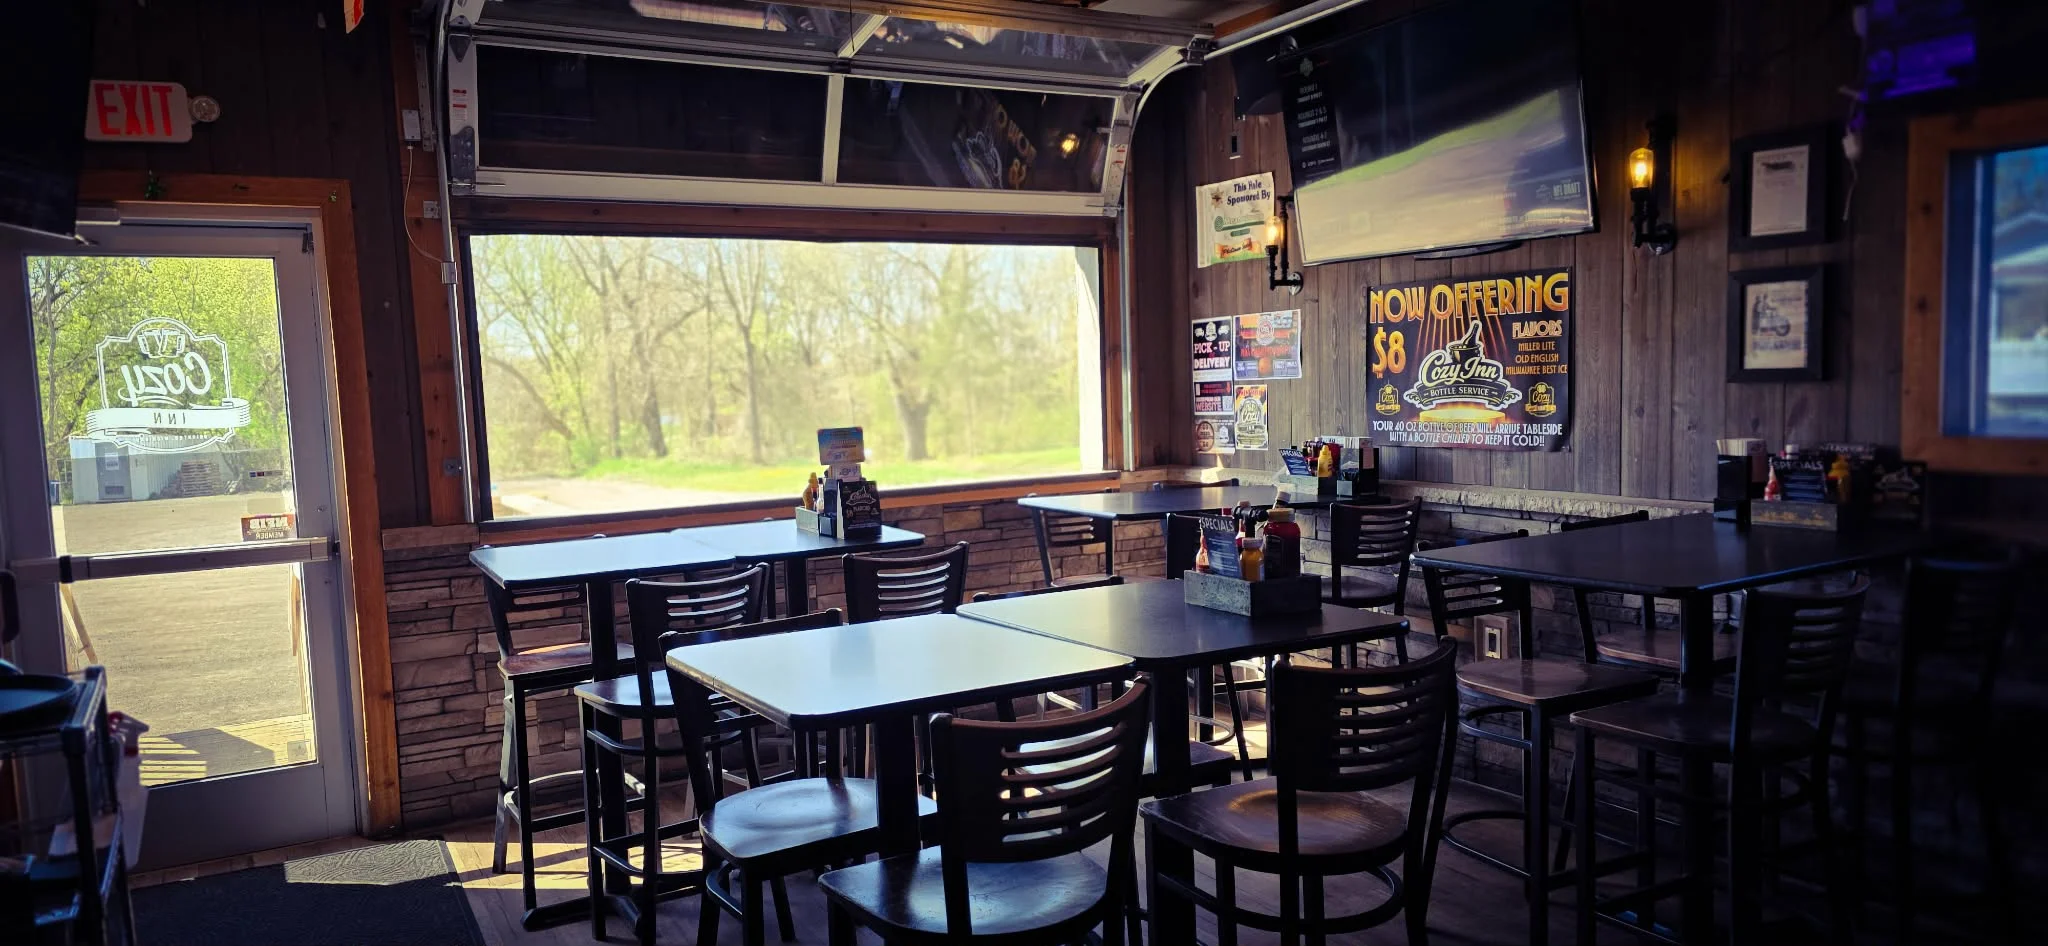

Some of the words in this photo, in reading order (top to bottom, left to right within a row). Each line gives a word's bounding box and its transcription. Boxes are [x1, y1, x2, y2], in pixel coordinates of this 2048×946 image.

[94, 83, 173, 137] EXIT
[1233, 183, 1247, 193] This
[1248, 180, 1262, 190] Hole
[1227, 191, 1260, 206] Sponsored
[1261, 189, 1271, 200] By
[1369, 286, 1426, 324] NOW
[1429, 272, 1569, 320] OFFERING
[1512, 320, 1562, 338] FLAVORS
[1194, 342, 1213, 353] PICK
[1219, 341, 1231, 352] UP
[1372, 326, 1407, 379] $8
[1518, 342, 1541, 351] MILLER
[1542, 341, 1556, 350] LITE
[1194, 357, 1231, 369] DELIVERY
[1515, 354, 1529, 364] OLD
[1530, 353, 1559, 363] ENGLISH
[1422, 352, 1463, 387] Cozy
[1460, 357, 1499, 379] Inn
[1505, 365, 1541, 375] MILWAUKEE
[1542, 365, 1557, 374] BEST
[1557, 364, 1568, 374] ICE
[1430, 388, 1457, 397] BOTTLE
[1458, 386, 1489, 396] SERVICE
[1373, 420, 1394, 431] YOUR
[1394, 421, 1404, 431] 40
[1405, 421, 1417, 431] OZ
[1418, 421, 1445, 432] BOTTLE
[1446, 422, 1458, 433] OF
[1459, 422, 1476, 433] BEER
[1477, 422, 1494, 434] WILL
[1495, 423, 1521, 434] ARRIVE
[1522, 423, 1563, 435] TABLESIDE
[1389, 431, 1407, 442] WITH
[1408, 432, 1413, 442] A
[1414, 432, 1441, 443] BOTTLE
[1441, 433, 1470, 444] CHILLER
[1471, 434, 1484, 444] TO
[1484, 434, 1503, 445] KEEP
[1503, 435, 1511, 446] IT
[1512, 435, 1545, 447] COLD!!
[1201, 516, 1235, 532] SPECIALS
